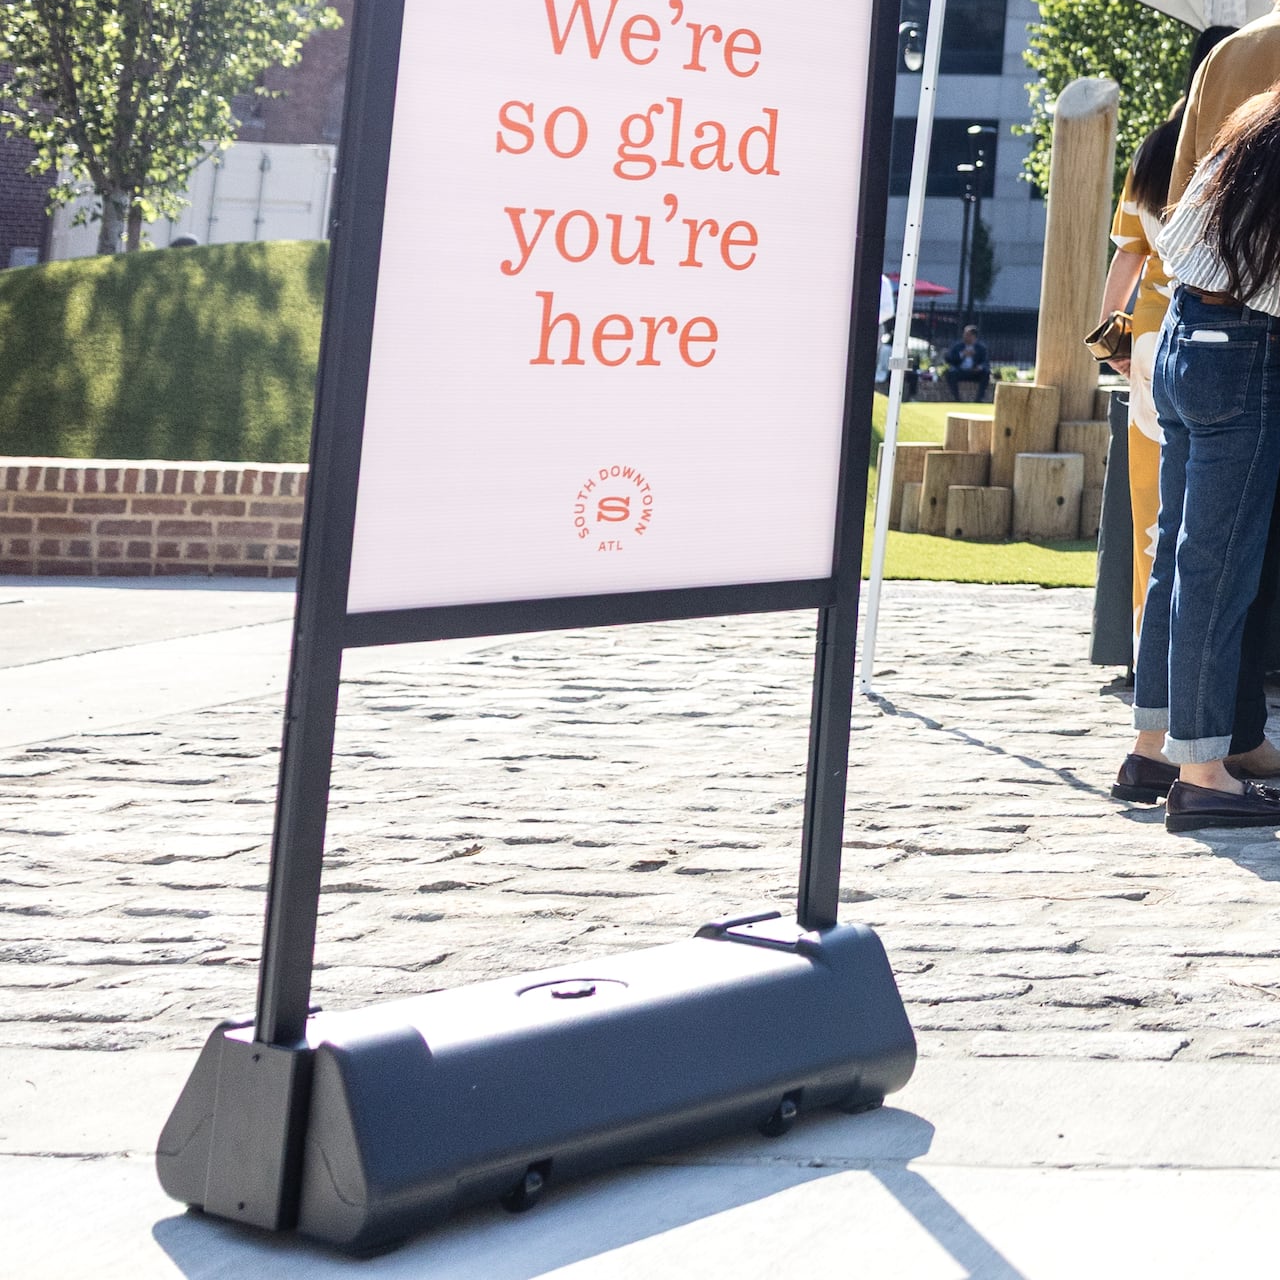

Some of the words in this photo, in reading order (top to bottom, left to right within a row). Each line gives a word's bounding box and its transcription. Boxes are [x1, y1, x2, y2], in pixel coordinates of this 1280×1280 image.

[496, 100, 588, 159] so
[613, 96, 780, 181] glad
[500, 193, 758, 276] you’re
[529, 291, 718, 367] here
[574, 478, 596, 539] SOUTH
[599, 465, 653, 535] DOWNTOWN
[596, 496, 630, 522] S
[598, 540, 623, 552] ATL
